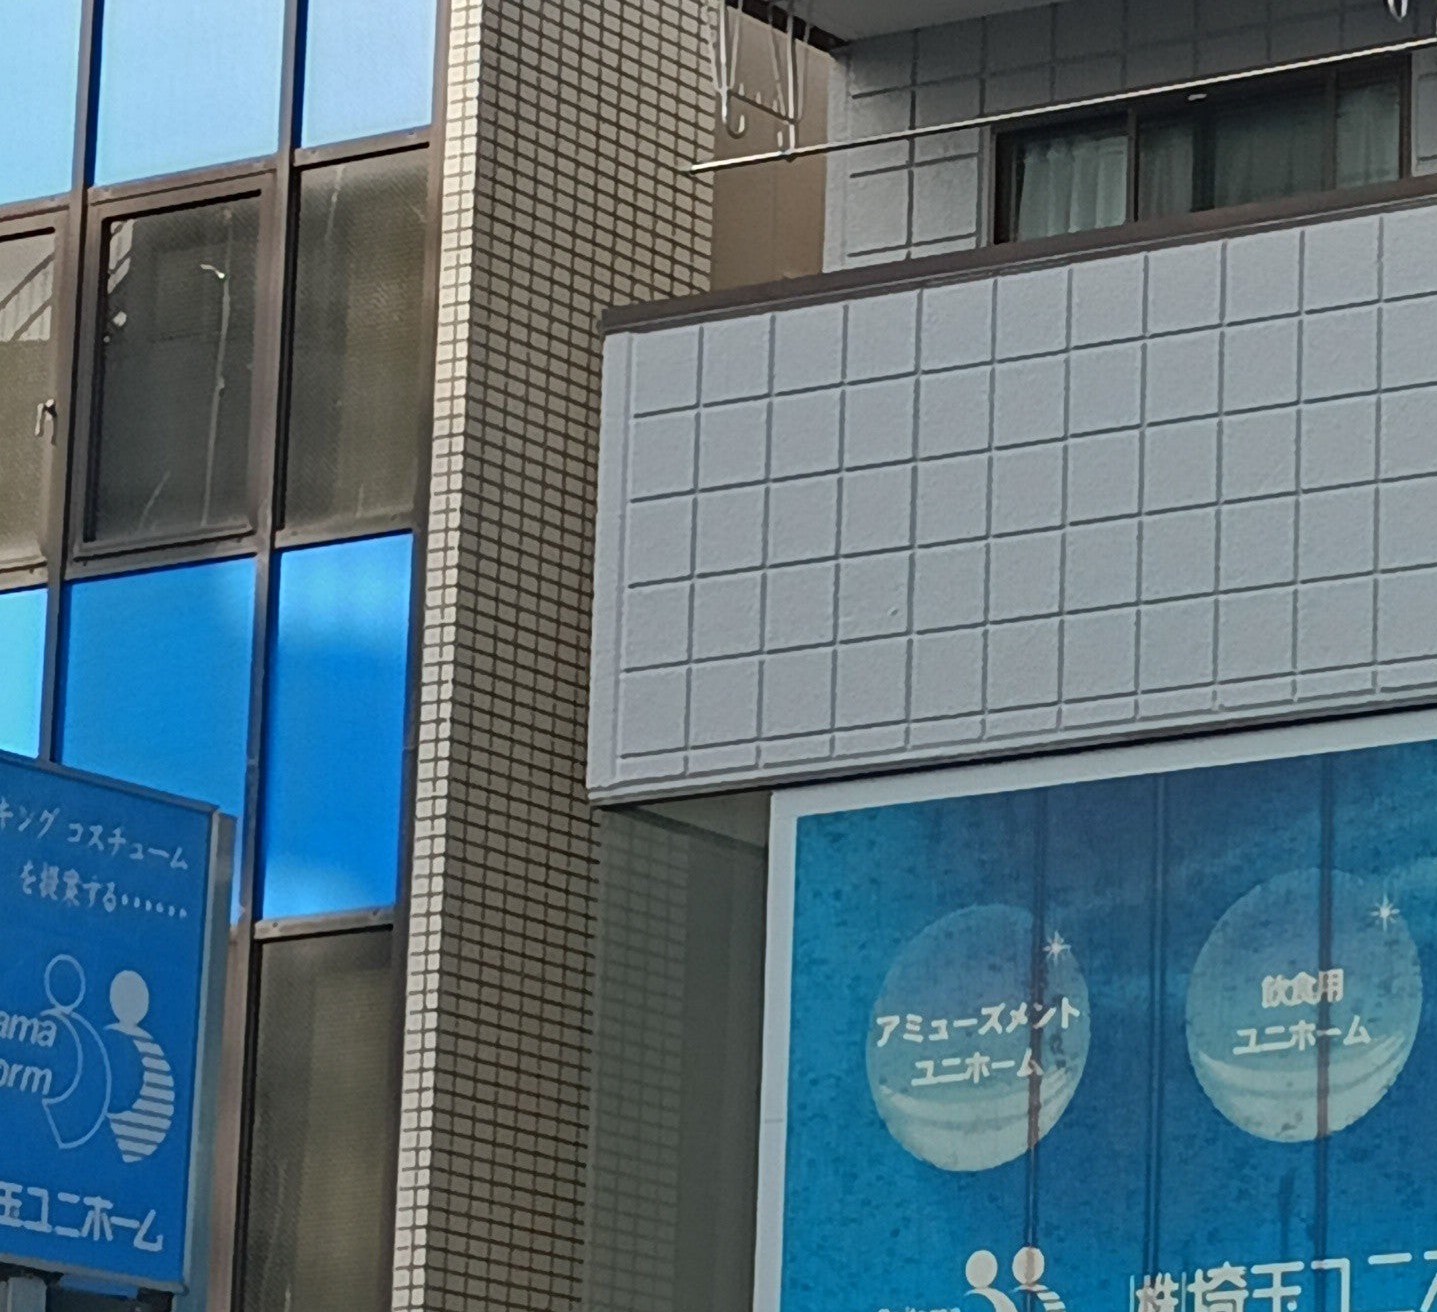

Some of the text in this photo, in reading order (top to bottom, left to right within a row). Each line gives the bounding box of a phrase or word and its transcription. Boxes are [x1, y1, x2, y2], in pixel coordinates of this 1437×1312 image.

[67, 822, 188, 870] コスチューム
[1261, 968, 1344, 1009] 飲食用
[876, 997, 1080, 1047] アミューズメント
[1232, 1015, 1372, 1055] ユニホーム
[911, 1047, 1044, 1086] ユニホーム
